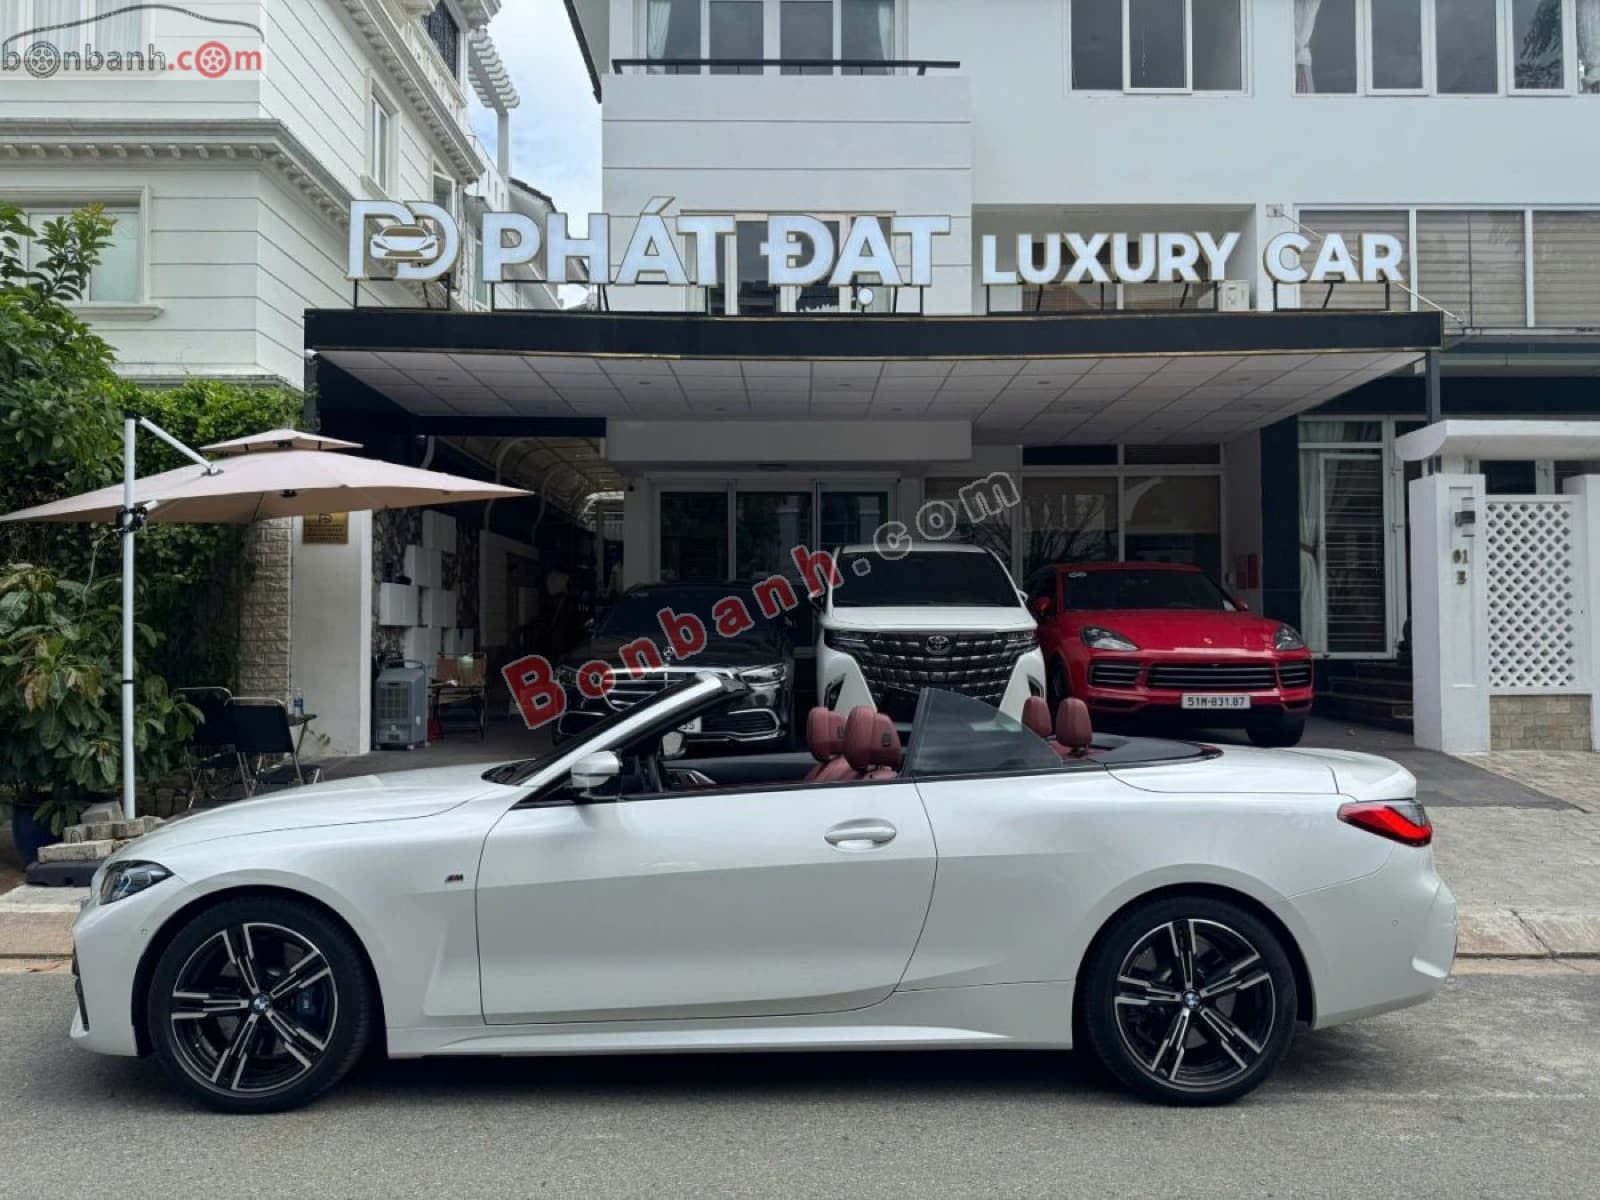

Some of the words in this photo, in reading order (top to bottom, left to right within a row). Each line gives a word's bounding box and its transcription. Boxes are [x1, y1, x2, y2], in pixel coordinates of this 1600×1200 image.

[481, 196, 737, 288] PHÁT
[760, 212, 952, 306] ĐẠT
[982, 231, 1241, 285] LUXURY
[1263, 231, 1406, 284] CAR
